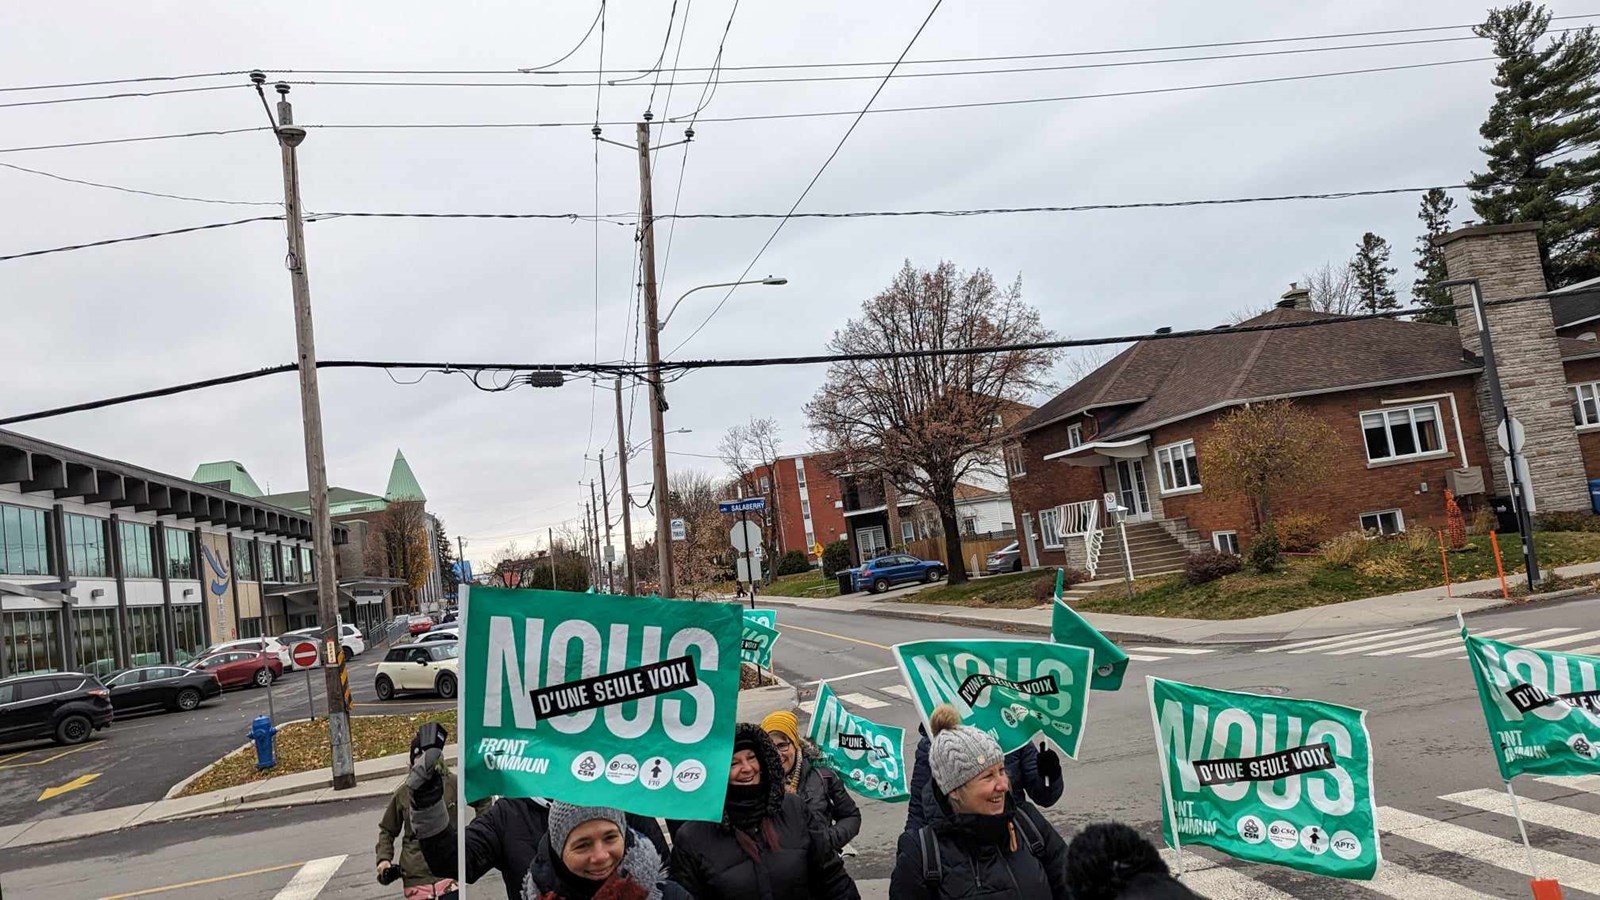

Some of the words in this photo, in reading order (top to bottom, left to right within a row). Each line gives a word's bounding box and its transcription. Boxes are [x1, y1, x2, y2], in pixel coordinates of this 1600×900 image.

[731, 502, 764, 512] SALABERRY
[483, 616, 719, 744] NOUS
[538, 685, 589, 715] D'UNE
[594, 673, 644, 701] SEULE
[648, 662, 690, 689] VOIX
[962, 676, 986, 702] D'UNE
[988, 676, 1021, 691] SEULE
[1023, 679, 1053, 694] VOIX
[1514, 686, 1549, 708] D'U
[478, 737, 529, 756] FRONT
[842, 736, 863, 748] D'UNE
[1160, 699, 1355, 816] NOUS
[1200, 762, 1244, 781] D'UNE
[1250, 754, 1289, 777] SEULE
[1291, 747, 1329, 770] VOIX
[577, 769, 595, 777] CSN
[621, 762, 637, 771] CSQ
[676, 771, 701, 780] APTS
[1177, 817, 1217, 836] MMUN
[1280, 828, 1297, 836] CSQ
[1244, 832, 1259, 840] CSN
[1333, 841, 1356, 850] APTS
